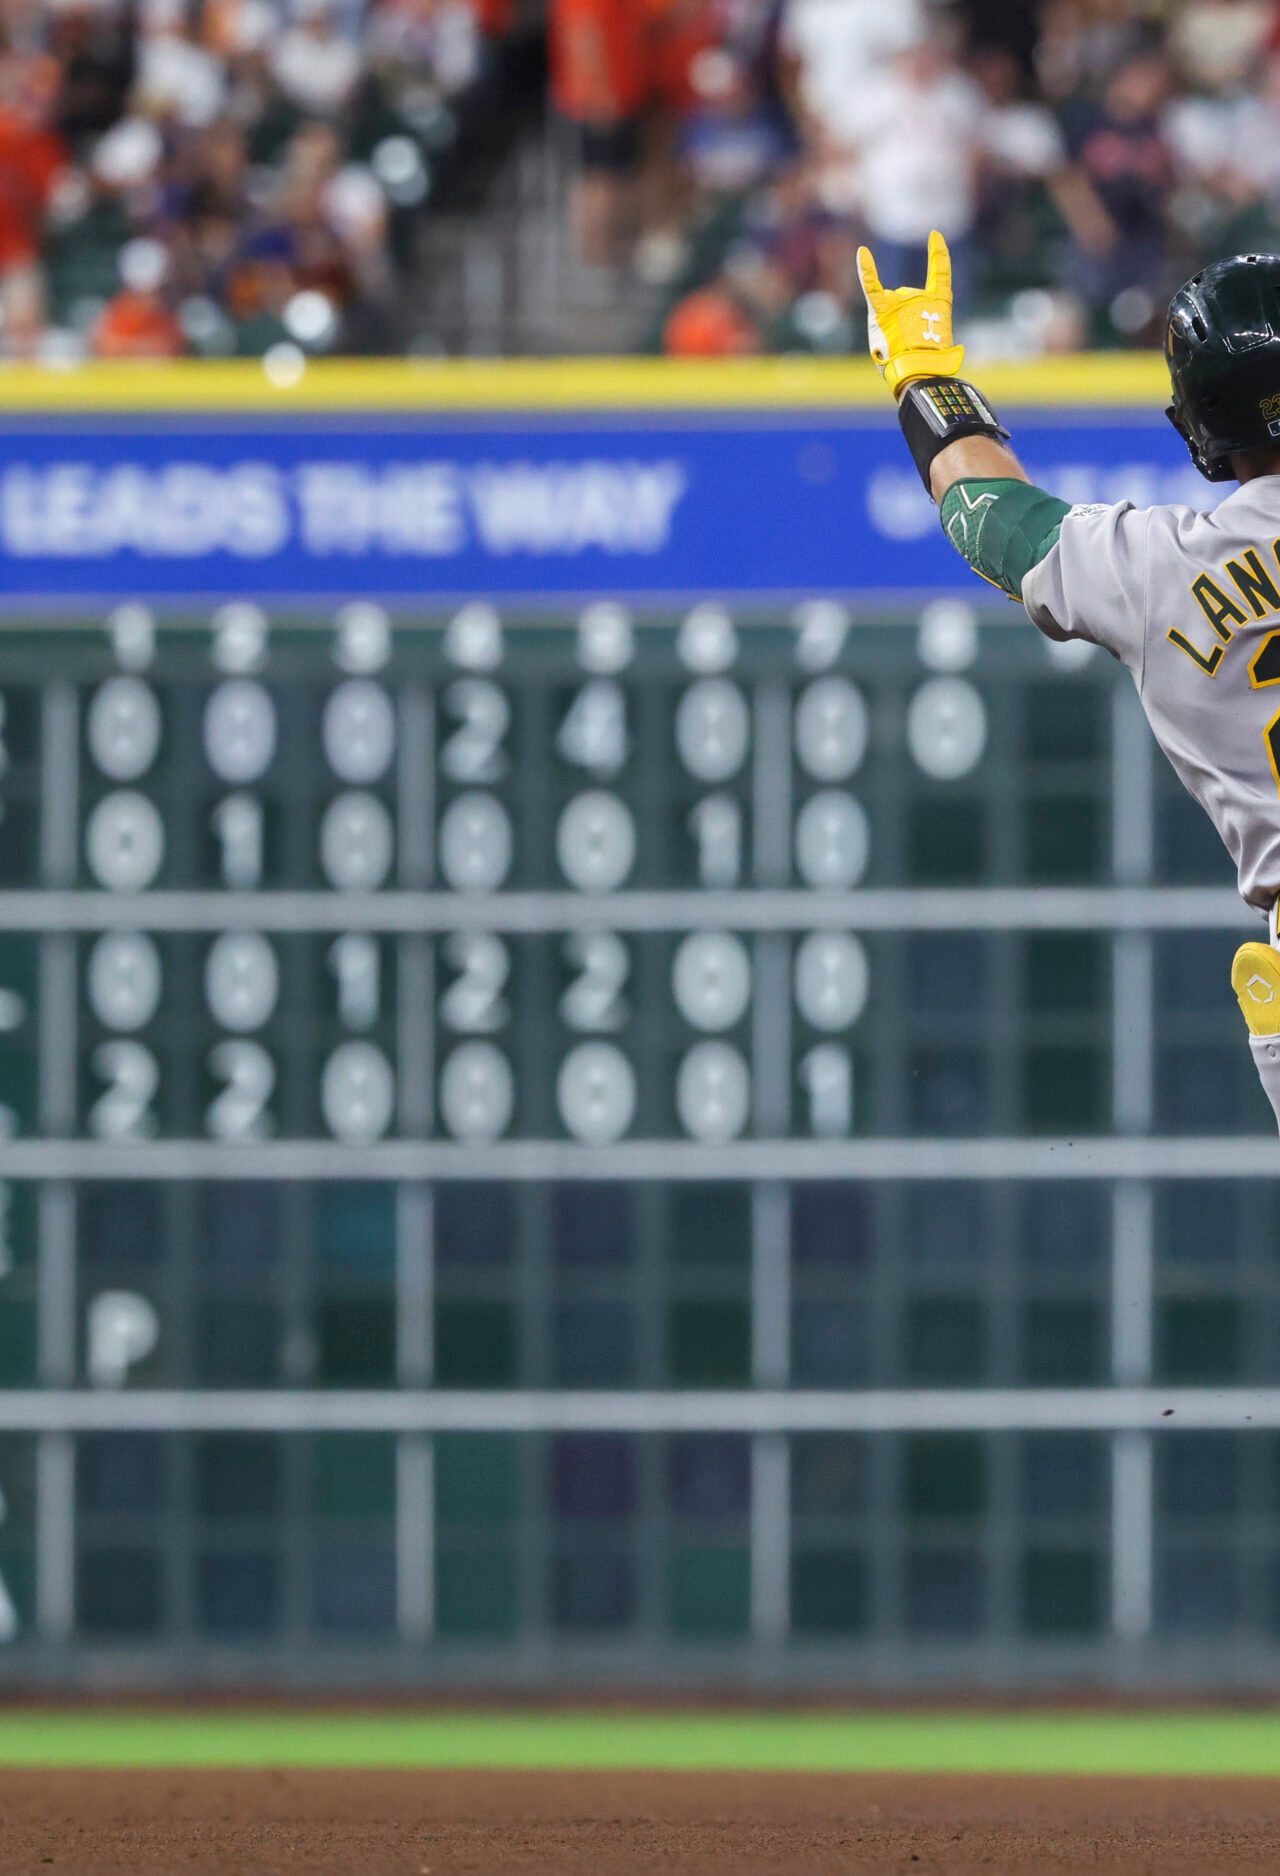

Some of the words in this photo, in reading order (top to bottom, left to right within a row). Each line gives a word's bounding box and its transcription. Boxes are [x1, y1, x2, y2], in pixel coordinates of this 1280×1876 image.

[2, 460, 292, 560] LEADS
[298, 460, 465, 556] THE
[468, 458, 687, 556] WAY
[89, 675, 161, 781] 0
[203, 676, 277, 784] 0
[322, 677, 395, 784] 0
[443, 677, 510, 784] 2
[556, 677, 629, 780] 4
[676, 675, 749, 782] 0
[795, 675, 868, 783] 0
[907, 675, 987, 781] 0
[87, 790, 164, 893] 0
[211, 792, 263, 890] 1
[320, 790, 393, 895] 0
[440, 790, 512, 895] 0
[556, 790, 636, 894] 0
[688, 792, 741, 892] 1
[796, 788, 869, 892] 0
[88, 929, 161, 1032] 0
[206, 929, 278, 1033] 0
[330, 930, 379, 1032] 1
[443, 930, 508, 1032] 2
[562, 930, 628, 1033] 2
[673, 929, 750, 1033] 0
[795, 929, 868, 1033] 0
[92, 1038, 158, 1142] 2
[207, 1038, 274, 1142] 2
[321, 1040, 394, 1146] 0
[440, 1040, 514, 1145] 0
[557, 1040, 636, 1145] 0
[676, 1040, 750, 1145] 0
[801, 1041, 852, 1140] 1
[88, 1290, 158, 1389] P
